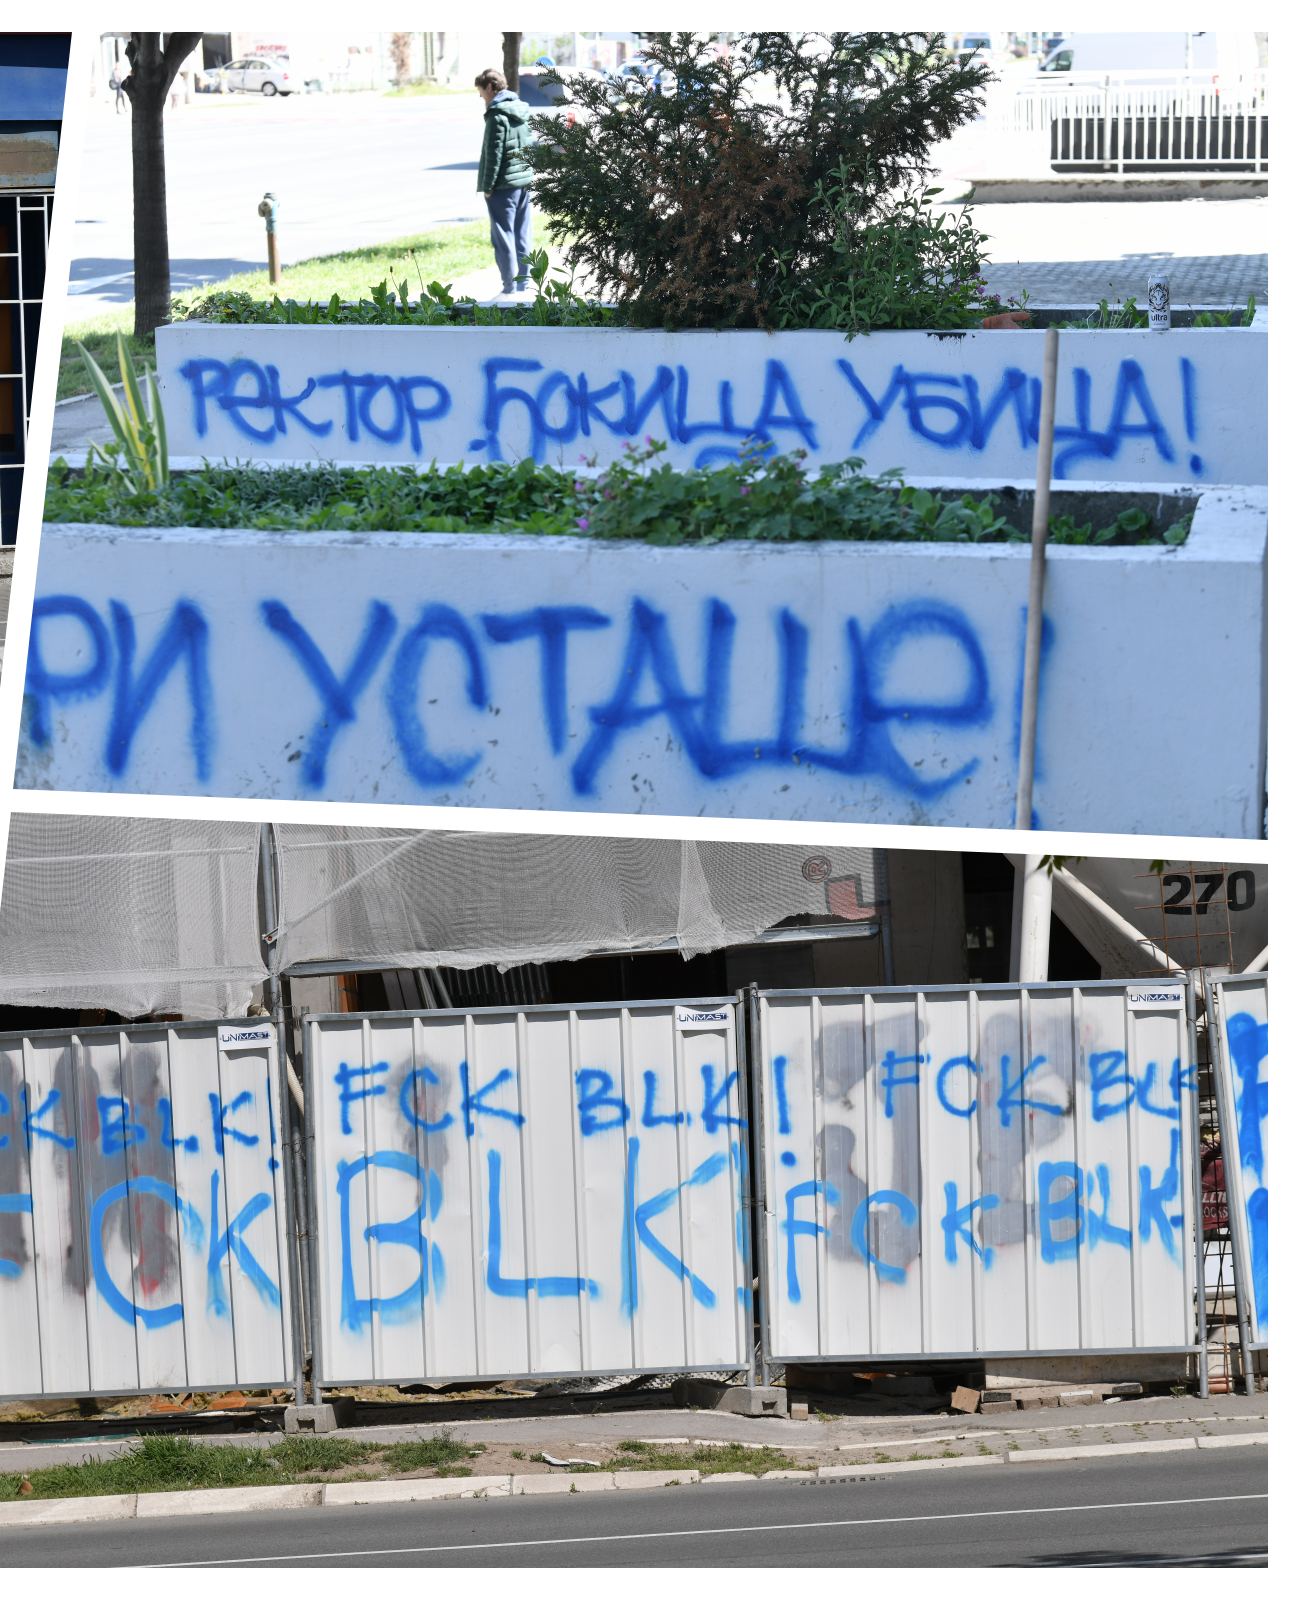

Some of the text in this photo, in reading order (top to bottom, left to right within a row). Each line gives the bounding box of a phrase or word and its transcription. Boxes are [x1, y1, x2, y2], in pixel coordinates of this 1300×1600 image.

[1150, 313, 1168, 322] ultra
[1161, 869, 1257, 916] 270
[334, 1060, 526, 1142] FCK
[881, 1049, 1078, 1128] FCK
[783, 1179, 1000, 1304] FCK
